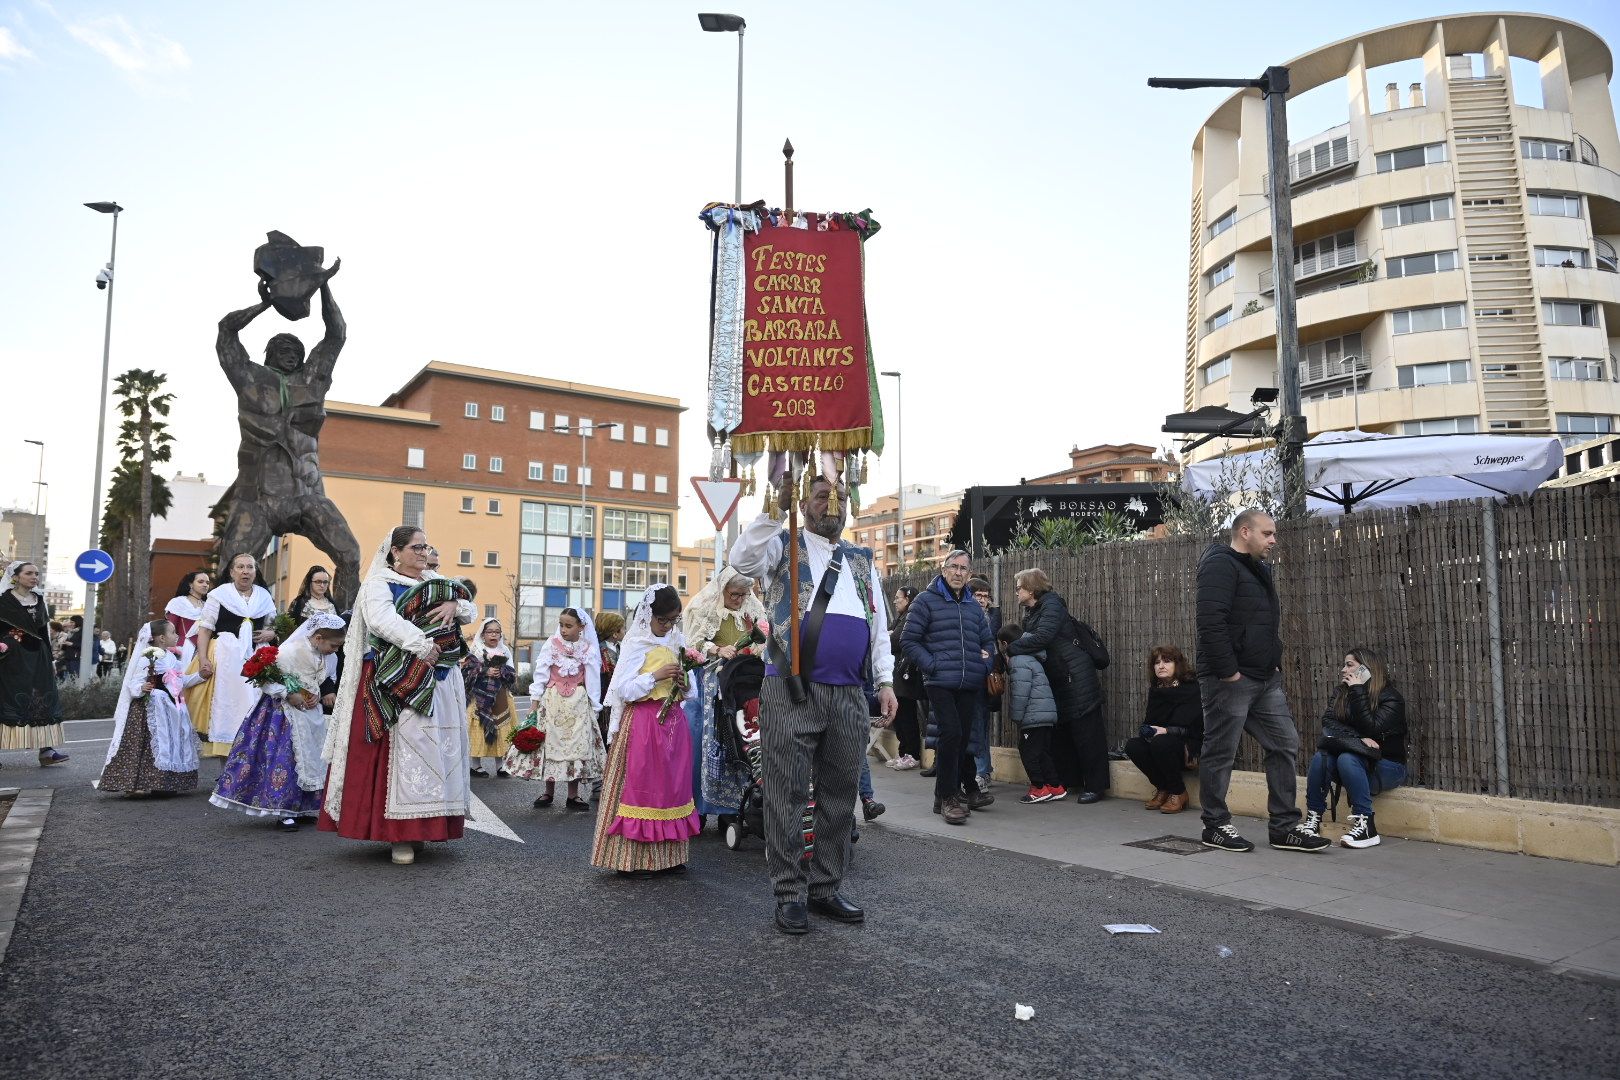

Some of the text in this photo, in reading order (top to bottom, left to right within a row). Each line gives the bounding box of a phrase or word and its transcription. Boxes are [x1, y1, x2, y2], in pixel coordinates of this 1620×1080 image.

[751, 244, 827, 273] FESTES
[753, 273, 822, 295] CARRER
[756, 294, 826, 315] SANTA
[746, 345, 854, 368] VOLTANTS
[747, 372, 844, 397] CASTELLÓ
[772, 398, 816, 418] 2003
[1473, 455, 1524, 466] Schweppes
[1059, 500, 1117, 510] BORSAO
